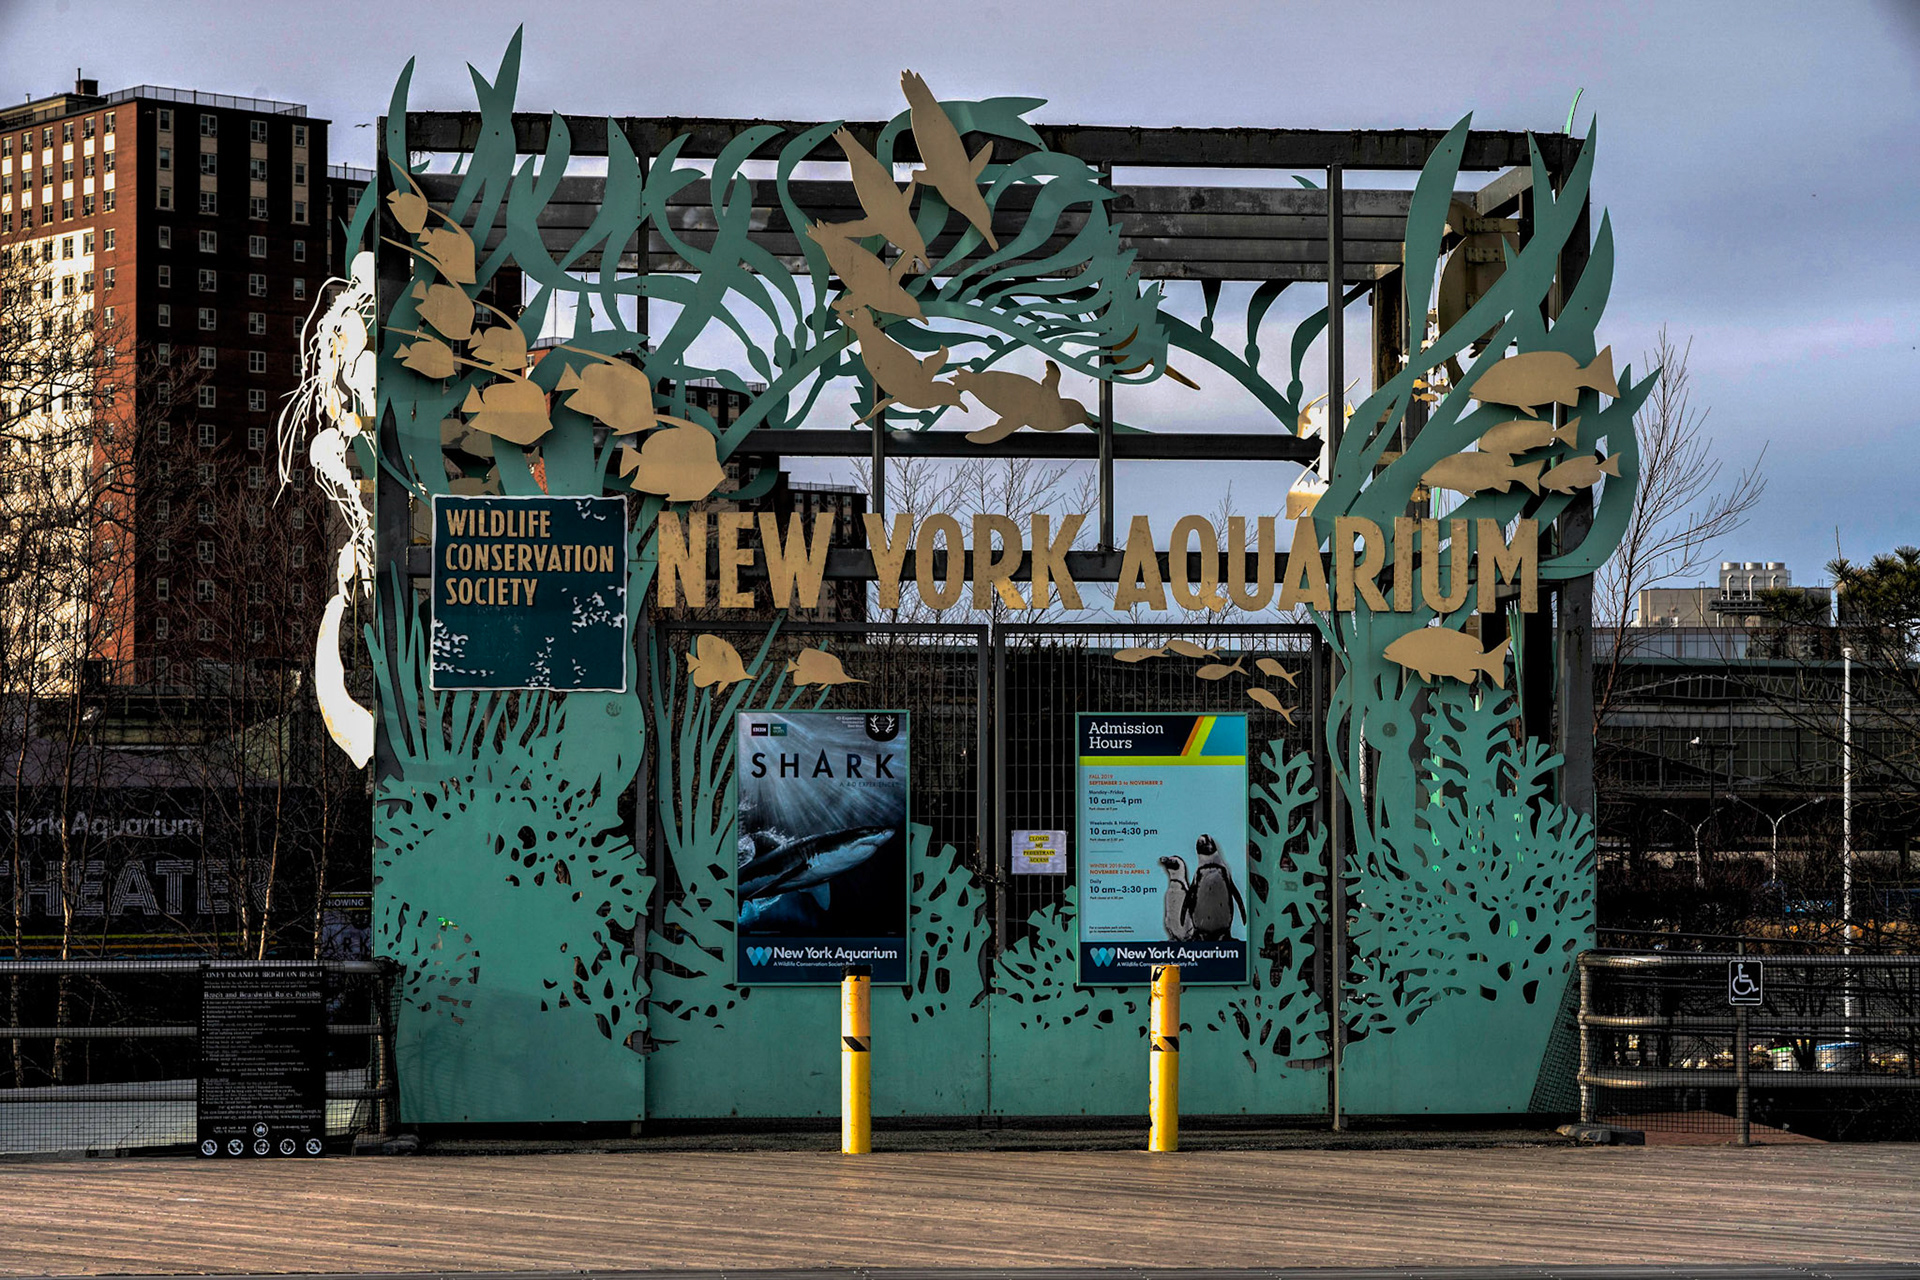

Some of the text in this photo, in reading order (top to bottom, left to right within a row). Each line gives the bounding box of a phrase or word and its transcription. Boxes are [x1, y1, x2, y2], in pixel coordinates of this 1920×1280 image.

[445, 509, 551, 538] WILDLIFE
[445, 543, 614, 573] CONSERVATION
[658, 511, 1539, 613] NEW YORK AQUARIUM
[445, 577, 538, 606] SOCIETY
[1088, 721, 1164, 735] Admission
[1088, 736, 1133, 749] Hours
[751, 748, 895, 779] SHARK
[1089, 796, 1099, 804] 10
[1128, 798, 1142, 806] pm
[6, 809, 203, 839] York Aquarium
[1090, 827, 1100, 835] 10
[1144, 829, 1158, 837] pm
[1090, 885, 1100, 893] 10
[1143, 887, 1157, 895] pm
[773, 946, 898, 962] New York Aquarium
[1116, 946, 1239, 962] New York Aquarium
